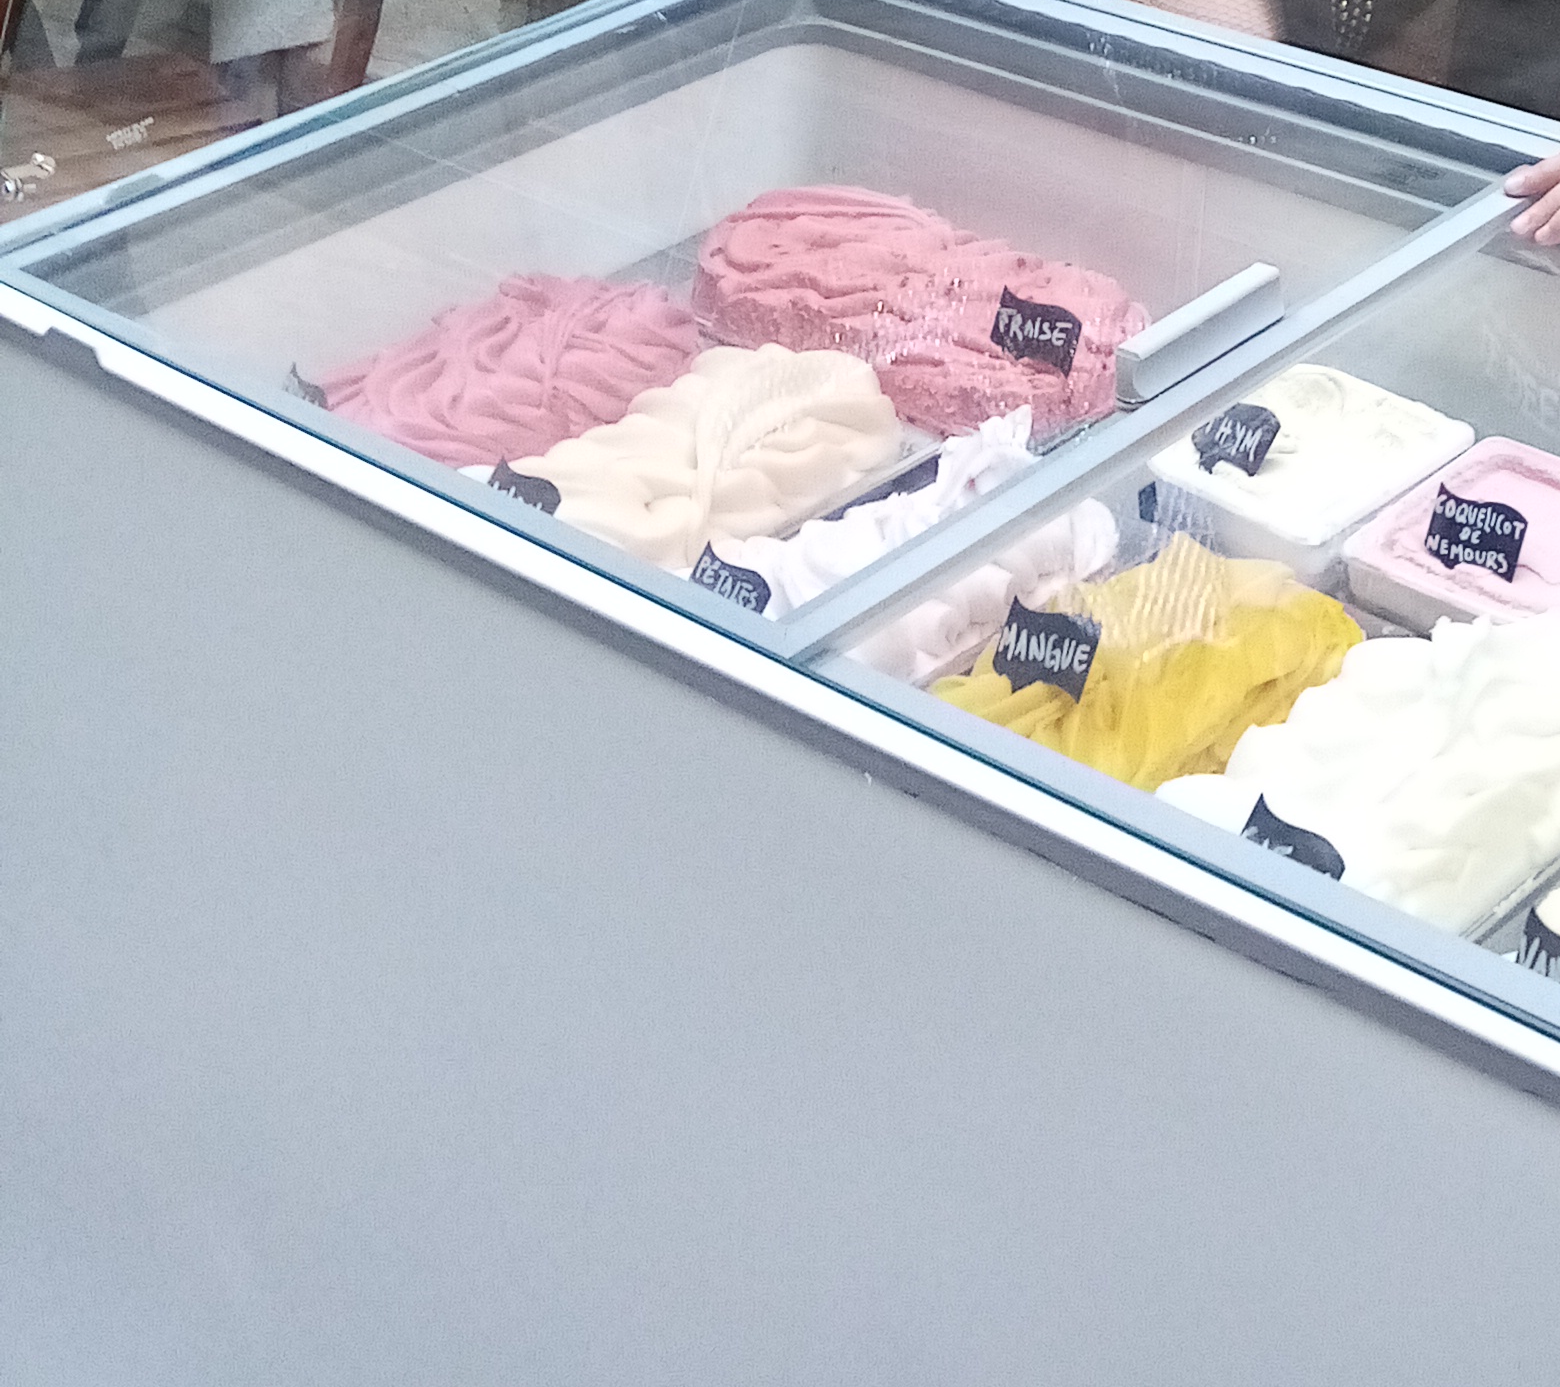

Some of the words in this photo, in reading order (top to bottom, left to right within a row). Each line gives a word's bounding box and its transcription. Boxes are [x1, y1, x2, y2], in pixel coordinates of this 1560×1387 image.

[998, 307, 1073, 346] FRAISE
[1435, 494, 1526, 540] COQUELICOT
[1458, 526, 1482, 545] DE
[1426, 533, 1509, 574] NEMOURS
[998, 622, 1091, 674] MANGUE
